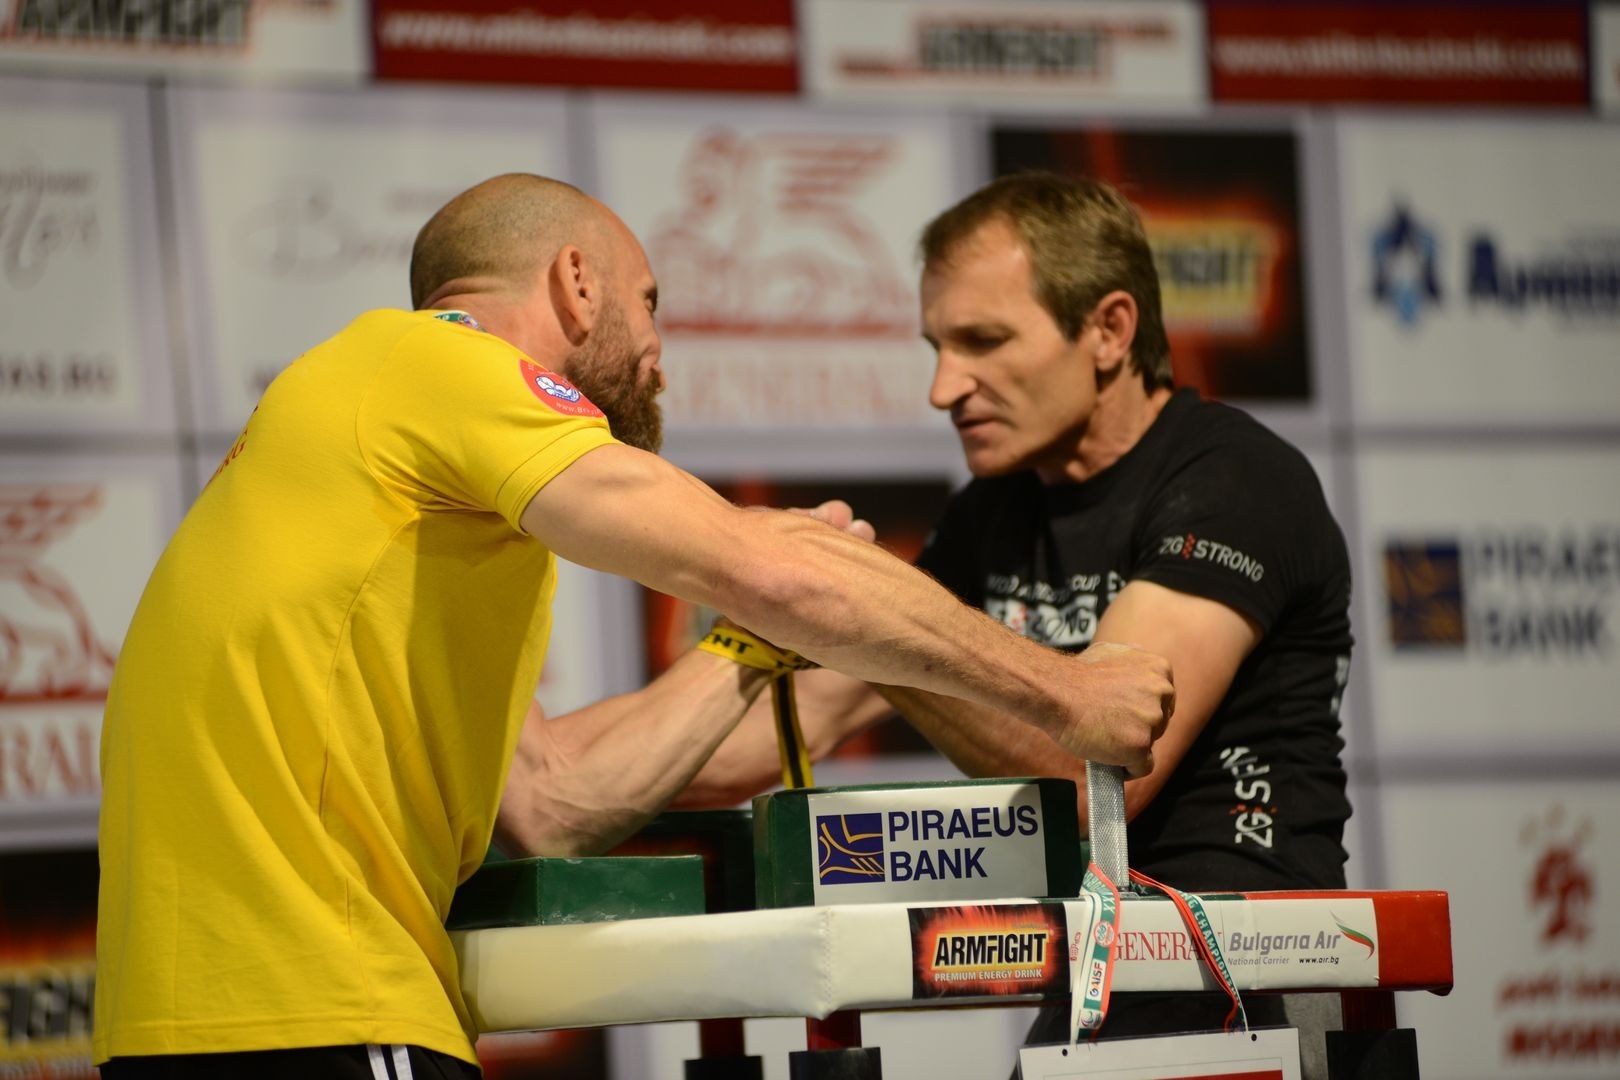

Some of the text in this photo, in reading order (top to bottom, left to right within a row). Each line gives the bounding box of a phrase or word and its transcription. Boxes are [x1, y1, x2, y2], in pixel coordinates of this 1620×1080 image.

[1193, 539, 1265, 582] STRONG
[888, 805, 1038, 842] PIRAEUS
[888, 847, 988, 882] BANK
[934, 933, 1047, 967] ARMFIGHT
[1229, 930, 1342, 955] Bulgaria Air
[934, 968, 1043, 982] PREMIUM ENERGY DRINK
[1227, 956, 1290, 966] National Carrier
[1299, 956, 1340, 965] www.air.bg
